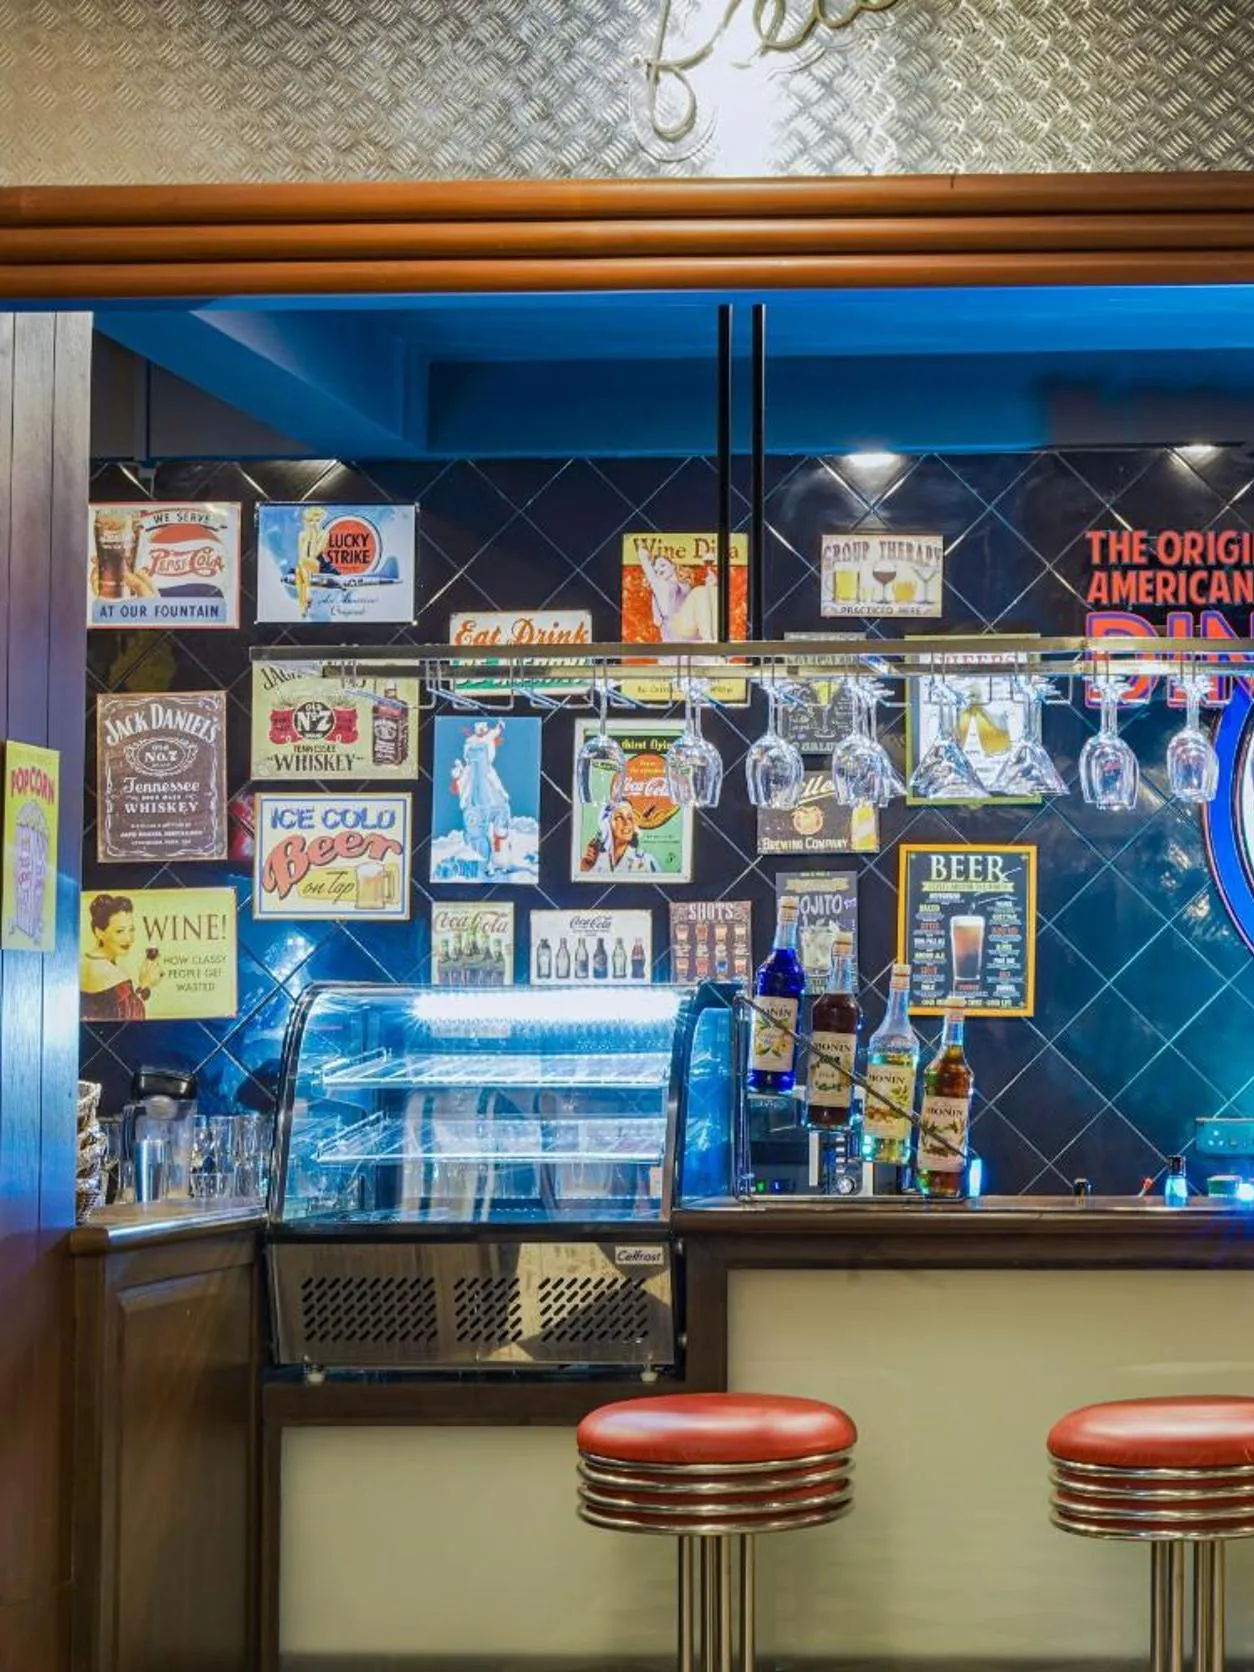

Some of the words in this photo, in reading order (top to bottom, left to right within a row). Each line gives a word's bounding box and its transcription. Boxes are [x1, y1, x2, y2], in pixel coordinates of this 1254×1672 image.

[153, 513, 169, 524] WE
[176, 511, 210, 523] SERVE
[328, 533, 370, 548] LUCKY
[633, 538, 687, 559] Wine
[693, 538, 739, 559] Dia
[823, 541, 870, 561] GROUP
[879, 540, 942, 561] THERAPY
[1084, 530, 1148, 565] THE
[327, 550, 370, 564] STRIKE
[1086, 570, 1254, 605] AMERICAN
[99, 605, 114, 617] AT
[119, 604, 147, 617] OUR
[154, 604, 219, 617] FOUNTAIN
[455, 620, 501, 645] Eat
[508, 618, 589, 645] Drink
[104, 710, 148, 746] JACK
[151, 703, 221, 744] DANIEL'S
[273, 754, 356, 772] WHISKEY
[11, 766, 55, 804] POPCORN
[123, 777, 201, 794] Tennessee
[124, 801, 199, 814] WHISKEY
[271, 807, 315, 829] ICE
[321, 807, 396, 830] COLD
[262, 831, 403, 900] Beer
[930, 855, 1005, 882] BEER
[325, 871, 355, 905] Tap
[688, 902, 734, 921] SHOTS
[800, 895, 843, 915] OJITO
[142, 914, 227, 941] WINE!
[163, 954, 188, 966] HOW
[192, 954, 227, 966] CLASSY
[168, 968, 201, 979] PEOPLE
[176, 982, 215, 992] WASTED
